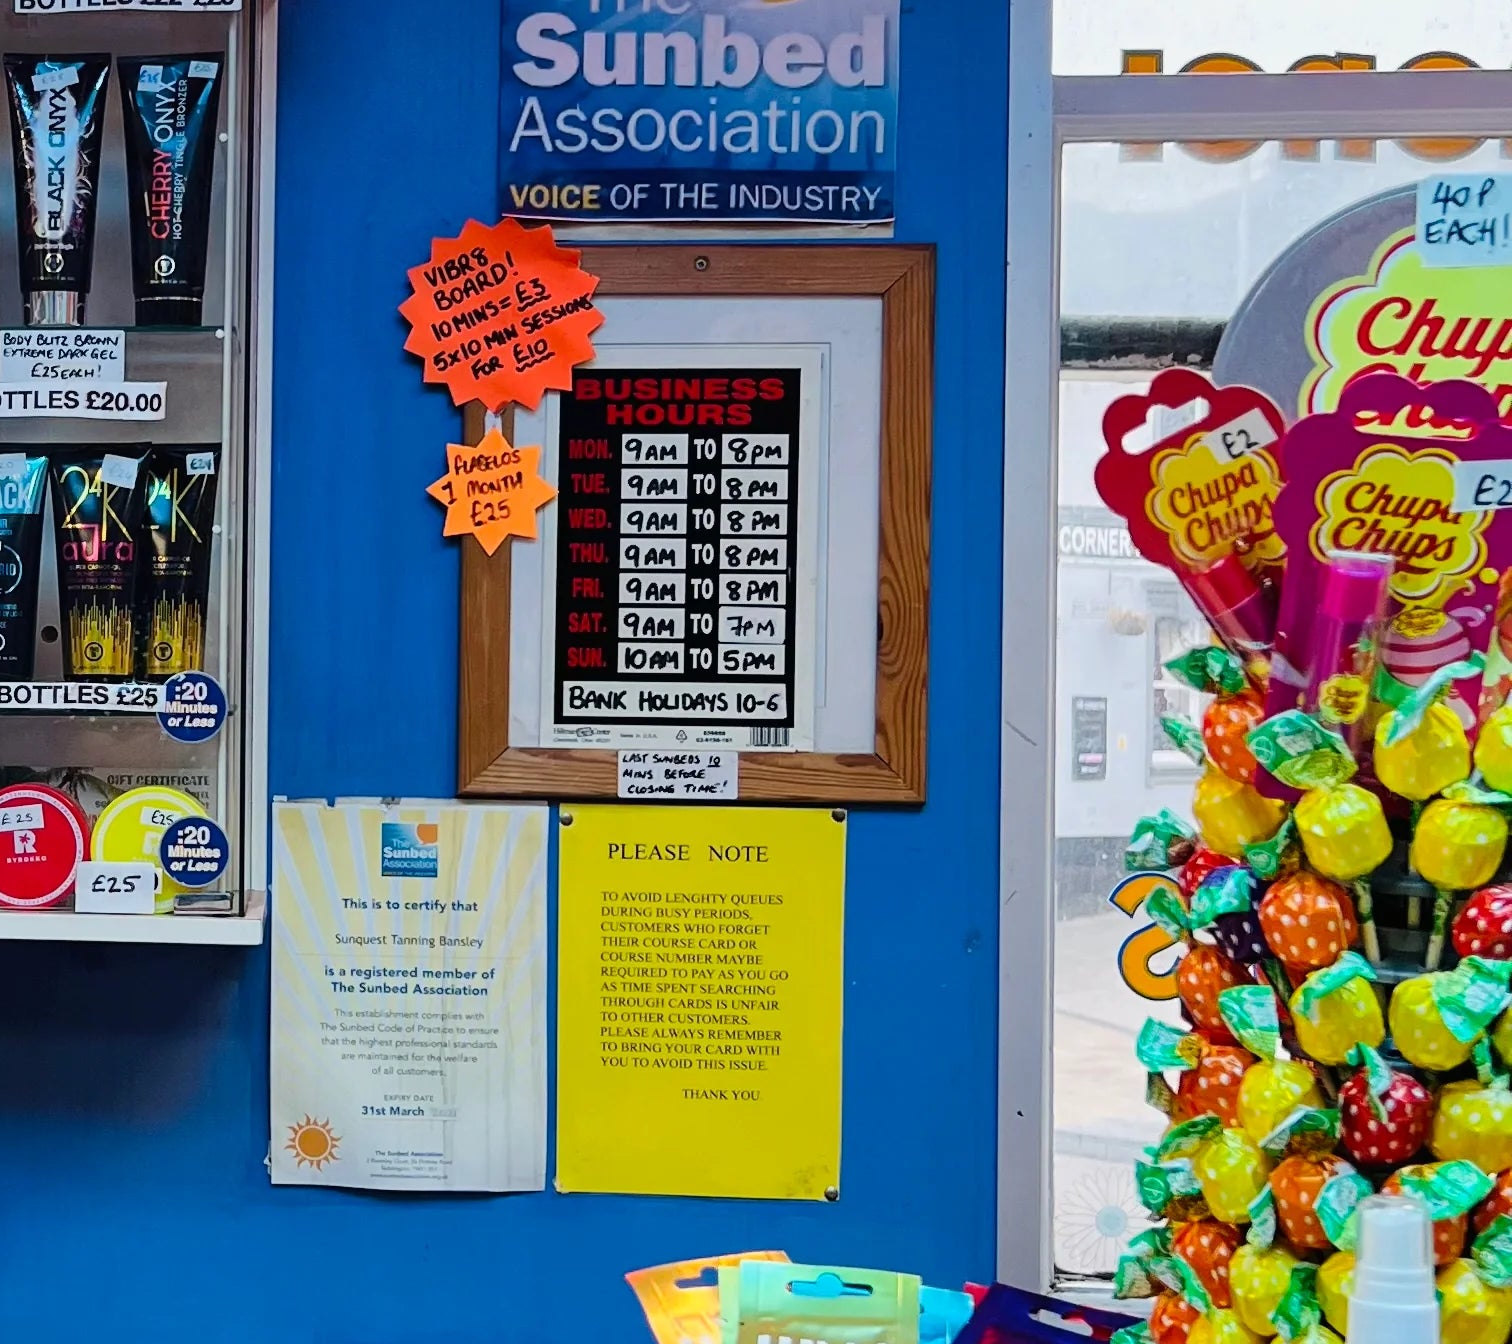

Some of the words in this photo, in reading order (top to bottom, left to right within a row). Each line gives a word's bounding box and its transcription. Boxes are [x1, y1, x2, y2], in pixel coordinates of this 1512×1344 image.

[512, 11, 886, 90] Sunbed
[48, 88, 68, 148] ONYX
[153, 80, 177, 144] ONYX
[509, 96, 885, 154] Association
[47, 156, 67, 232] BLACK
[151, 148, 170, 240] CHERRY
[510, 183, 601, 211] VOICE
[609, 183, 652, 209] OF
[660, 184, 718, 210] THE
[729, 184, 882, 213] INDUSTRY
[424, 247, 488, 287] VIBR8
[434, 251, 518, 310] BOARD!
[484, 324, 519, 349] MIN
[521, 293, 593, 334] SESSIONS
[4, 333, 32, 346] BODY
[38, 334, 68, 346] BLITZ
[3, 348, 53, 359] EXTREME
[58, 348, 90, 360] DARK
[91, 348, 118, 360] GEL
[471, 356, 504, 379] FOR
[513, 339, 548, 364] £10
[575, 378, 785, 400] BUSINESS
[85, 391, 162, 412] £20.00
[606, 404, 752, 426] HOURS
[568, 439, 612, 460] MON.
[693, 439, 717, 459] TO
[467, 471, 524, 497] MONTH
[1168, 461, 1260, 521] Chupa
[469, 501, 512, 526] £25
[1186, 489, 1274, 552] Chups
[1331, 515, 1456, 561] Chups
[568, 613, 607, 633] SAT.
[690, 613, 713, 634] TO
[567, 648, 607, 668] SUN.
[689, 648, 712, 669] TO
[723, 648, 775, 671] 5PM
[116, 687, 158, 707] £25
[165, 700, 218, 715] Minutes
[568, 686, 628, 711] BANK
[638, 690, 729, 713] HOLIDAYS
[736, 692, 781, 713] 10-6
[167, 717, 182, 727] or
[185, 715, 216, 728] Less
[136, 775, 210, 786] CERTIFICATE
[6, 855, 47, 864] BYROKKO
[608, 843, 690, 861] PLEASE
[708, 845, 769, 862] NOTE
[92, 874, 141, 893] £25
[342, 898, 368, 909] This
[372, 899, 382, 909] is
[386, 900, 400, 909] to
[404, 899, 446, 913] certify
[452, 900, 478, 912] that
[601, 891, 618, 902] TO
[622, 892, 662, 903] AVOID
[666, 892, 728, 904] LENGHTY
[731, 894, 783, 906] QUEUES
[335, 933, 387, 946] Sunquest
[391, 935, 435, 948] Tanning
[440, 936, 484, 949] Bansley
